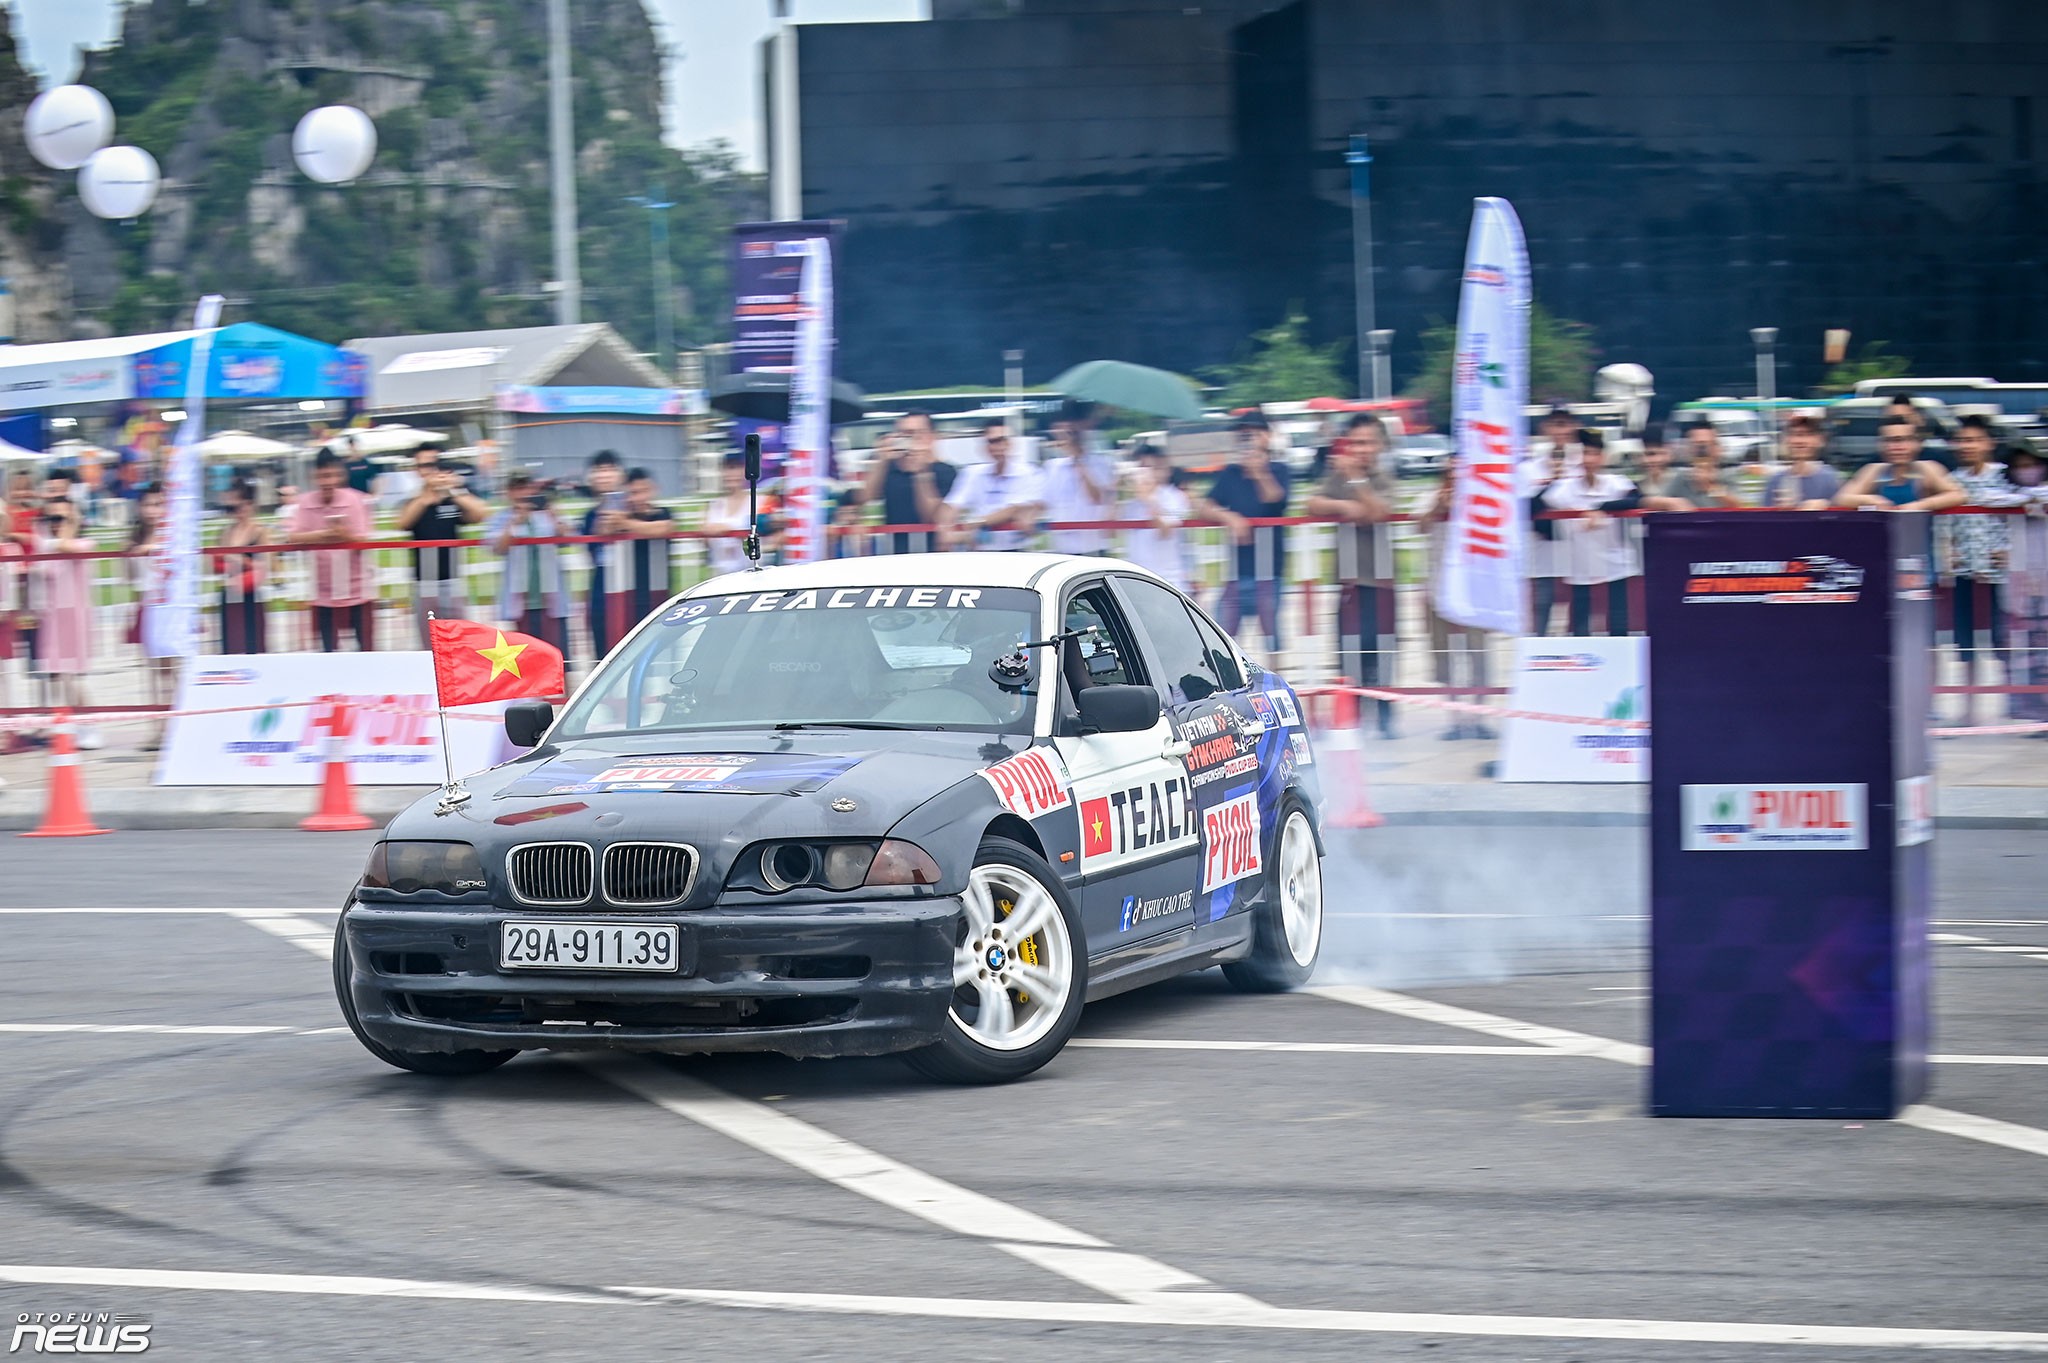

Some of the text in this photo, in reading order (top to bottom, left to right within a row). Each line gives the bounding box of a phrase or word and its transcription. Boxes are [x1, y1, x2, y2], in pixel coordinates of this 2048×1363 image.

[665, 587, 983, 622] 39 TEACHER
[769, 661, 822, 673] RECARO
[1176, 714, 1218, 741] VIETNAM
[1186, 735, 1237, 772] GYMKHANA
[599, 768, 718, 781] PVOIL
[985, 752, 1066, 814] PVOIL
[1207, 800, 1258, 886] PVOIL
[1142, 898, 1164, 920] KHUC
[1162, 894, 1178, 915] CAO
[1177, 889, 1193, 911] THE
[507, 927, 671, 965] 29A-911.39
